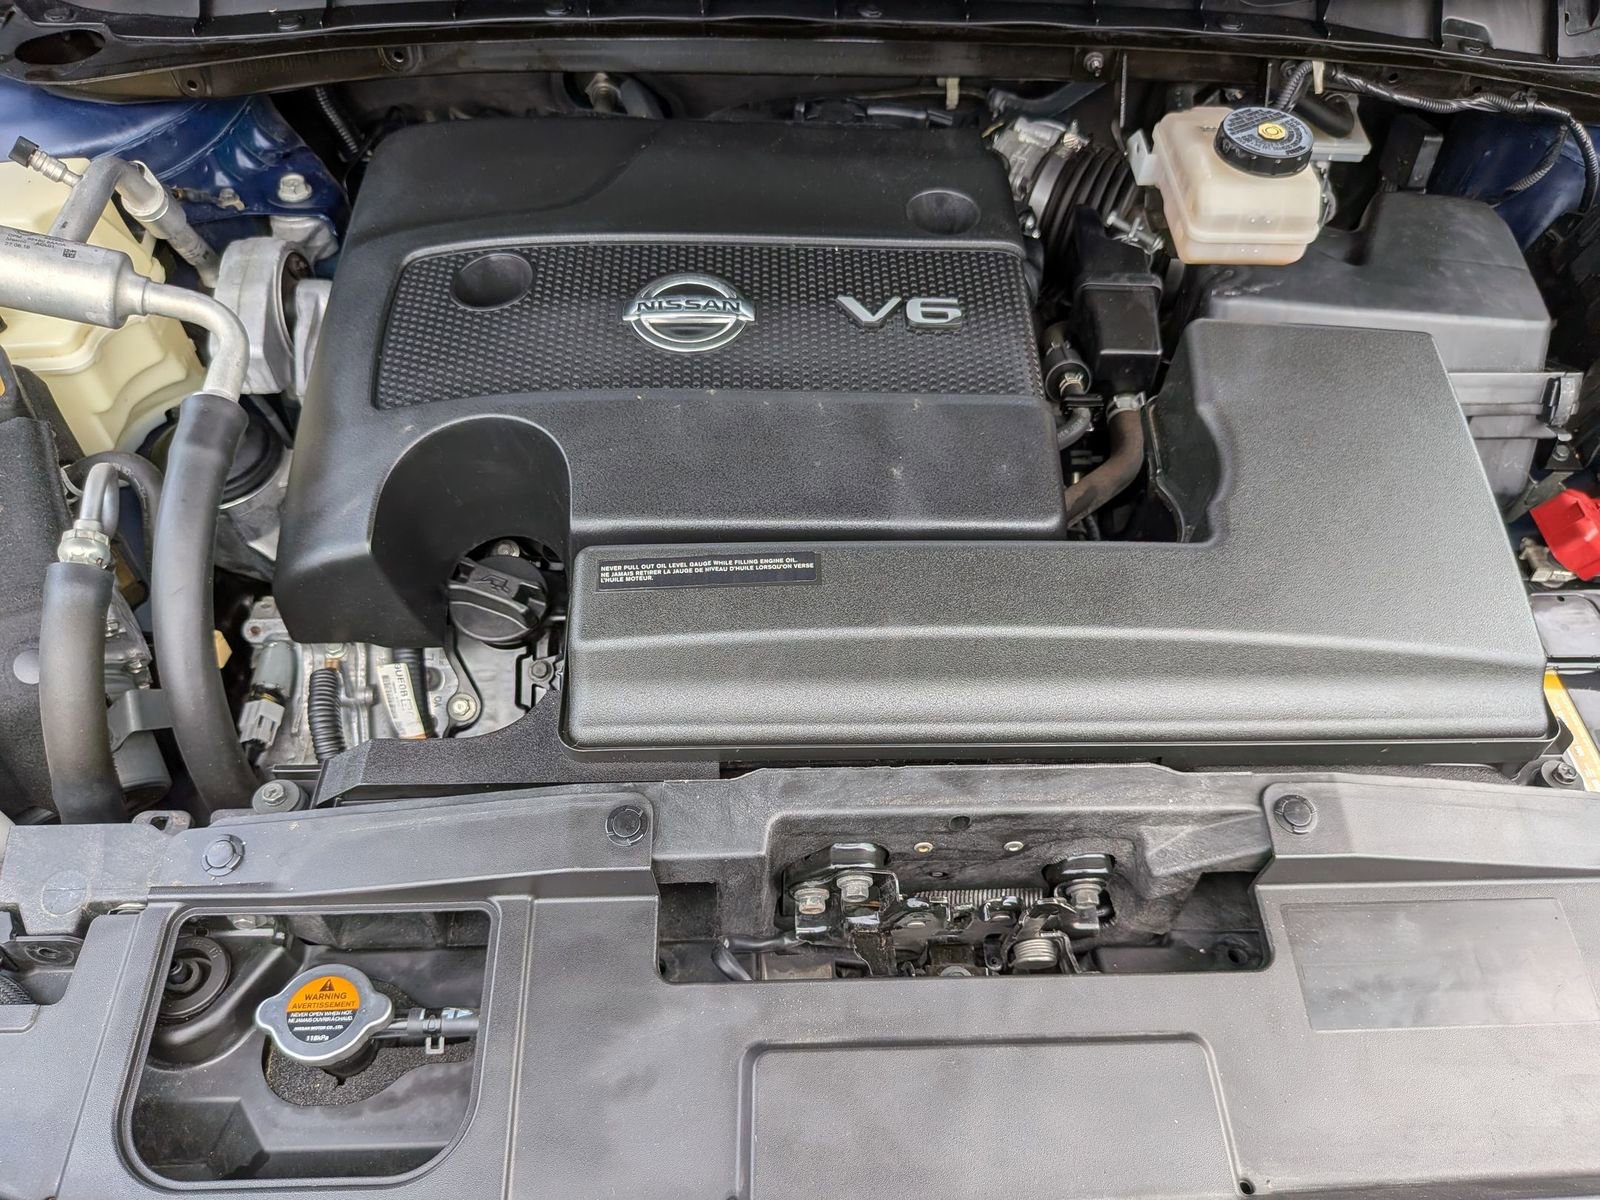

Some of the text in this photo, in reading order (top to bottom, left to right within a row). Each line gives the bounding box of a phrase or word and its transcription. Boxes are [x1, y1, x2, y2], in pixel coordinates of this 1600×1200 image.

[636, 300, 741, 313] NISSAN
[837, 295, 963, 327] V6
[305, 992, 347, 1000] WARNING
[292, 1001, 355, 1009] AVERTISSEMENT
